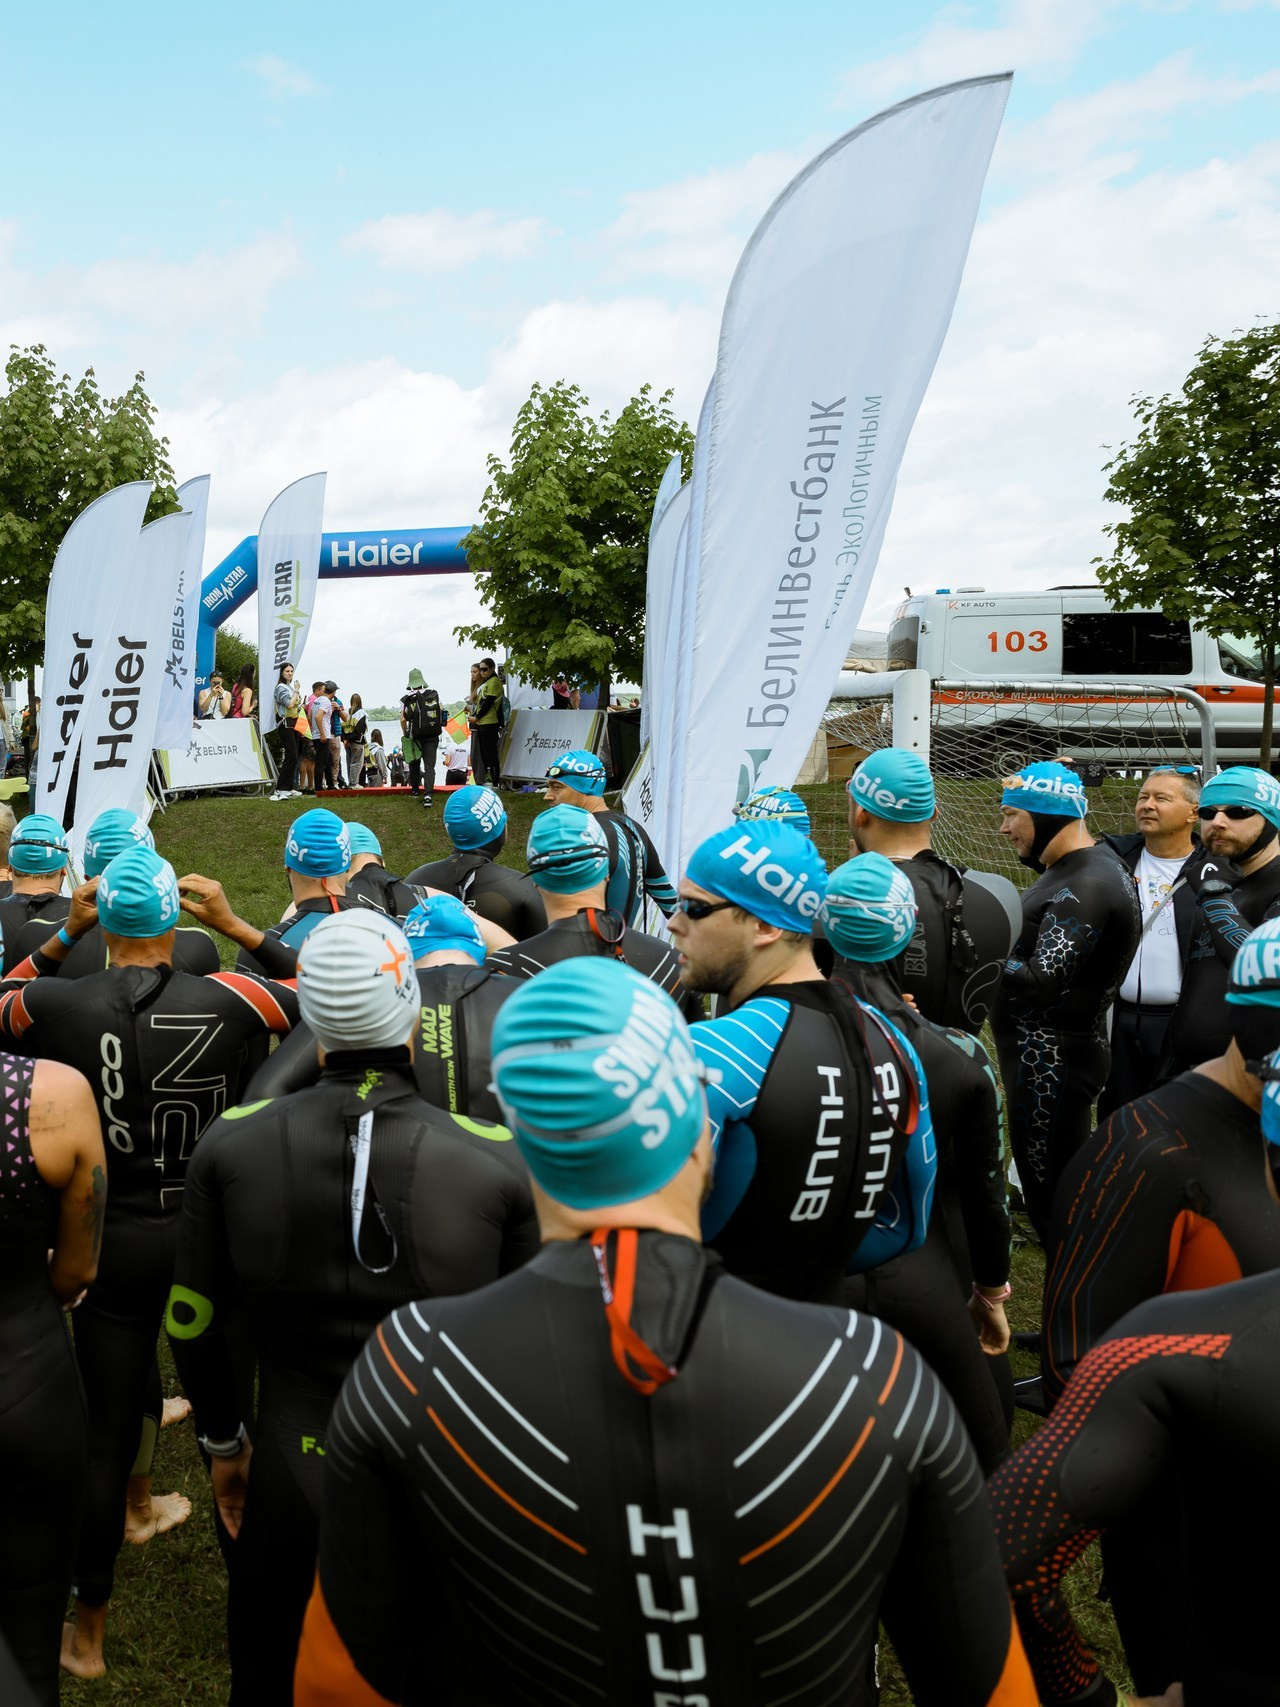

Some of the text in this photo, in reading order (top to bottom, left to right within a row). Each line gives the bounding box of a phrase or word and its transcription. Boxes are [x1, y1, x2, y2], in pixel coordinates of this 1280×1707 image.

[331, 538, 424, 568] Haier
[746, 395, 848, 729] Белинвестбанк
[202, 564, 245, 611] IRON STAR
[274, 559, 293, 671] IRON STAR
[987, 630, 1049, 653] 103
[93, 635, 148, 771] Haier
[202, 744, 238, 756] BELSTAR
[538, 738, 572, 750] BELSTAR
[421, 1006, 438, 1053] MAD
[438, 1003, 453, 1059] WAVE
[100, 1032, 135, 1154] orca
[446, 1059, 457, 1113] SMOOTH SKIN
[789, 1065, 845, 1222] HUUB
